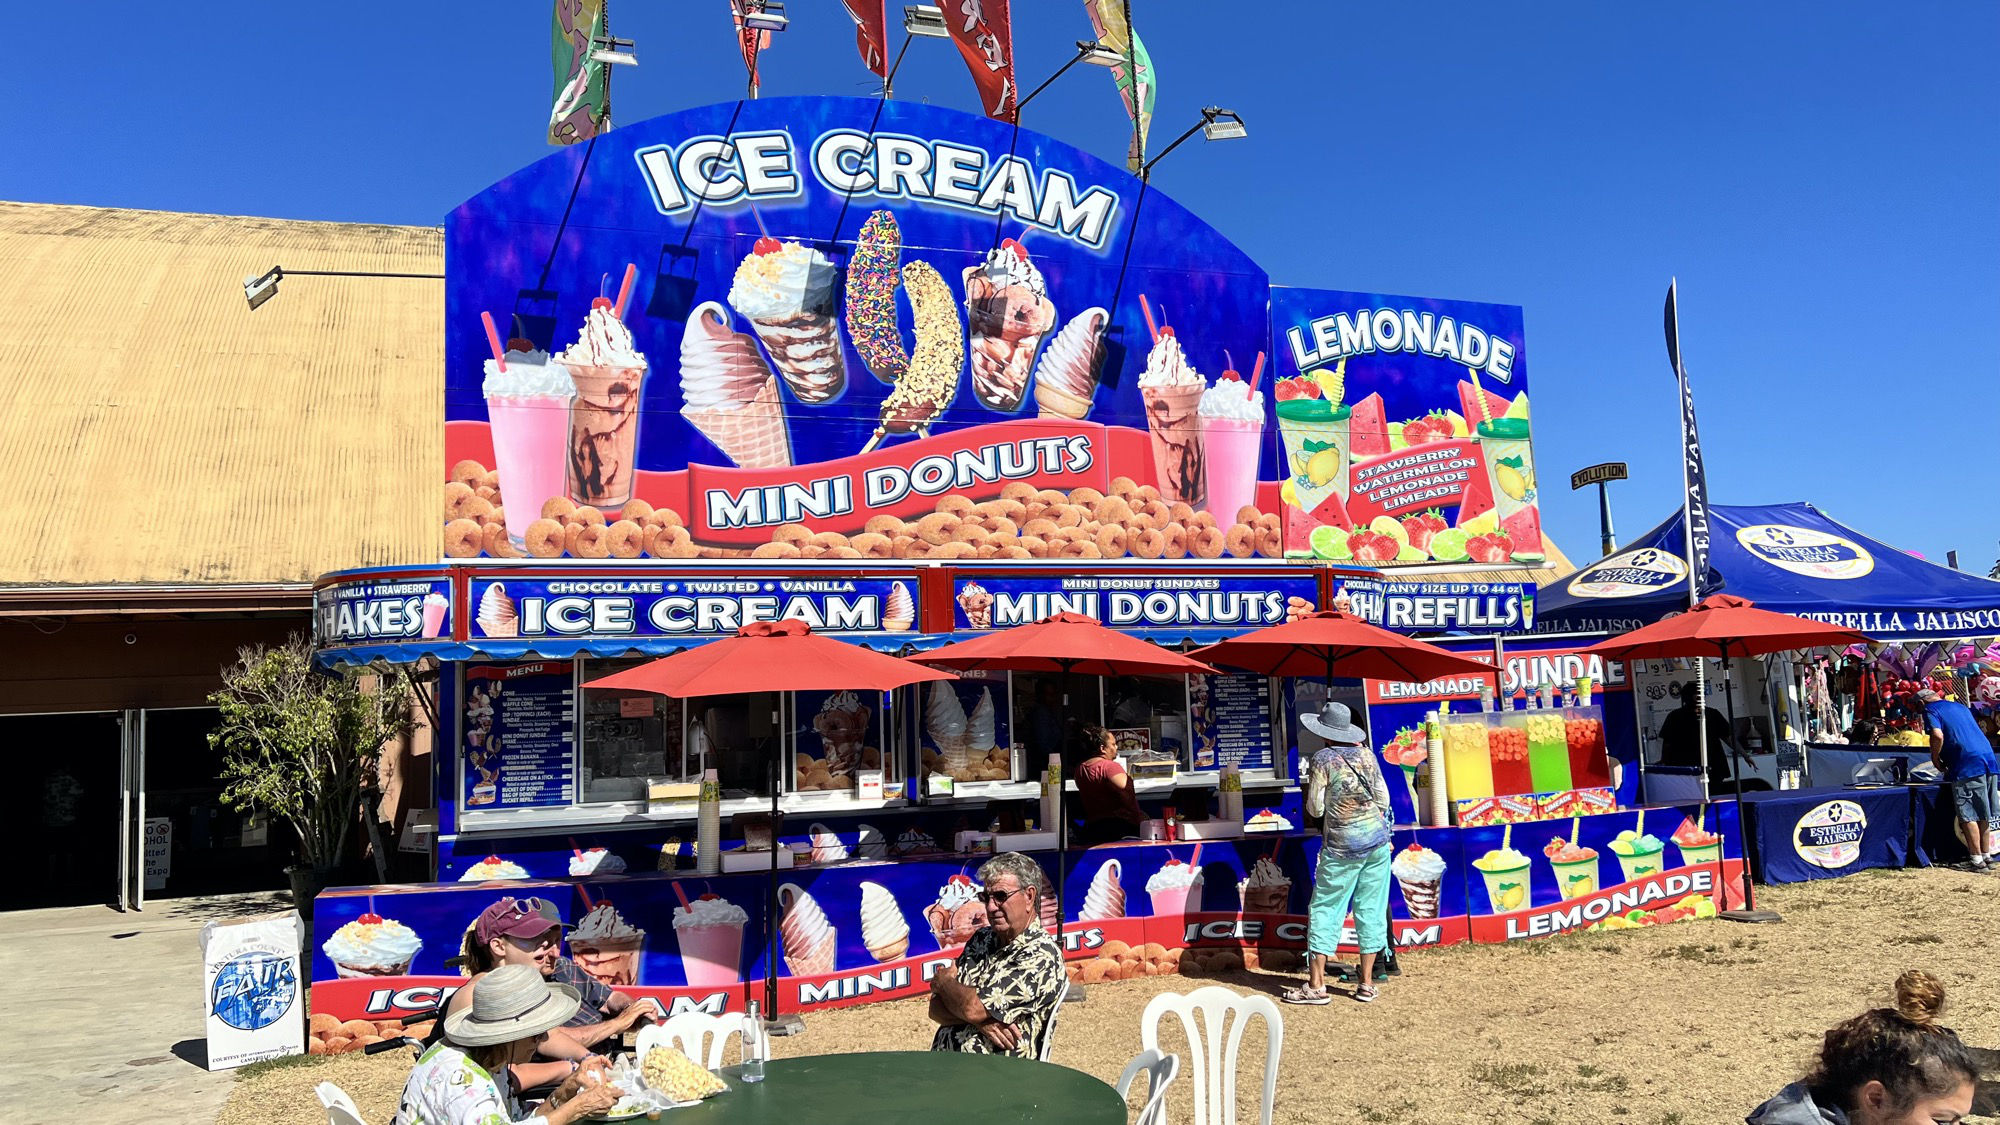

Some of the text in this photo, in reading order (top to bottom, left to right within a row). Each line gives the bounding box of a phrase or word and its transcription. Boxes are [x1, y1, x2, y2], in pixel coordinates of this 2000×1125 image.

[642, 131, 1118, 246] ICE CREAM
[1288, 308, 1514, 384] LEMONADE
[1357, 447, 1462, 481] STAWBERRY
[706, 436, 1093, 529] MINI DONUTS
[1352, 457, 1478, 495] WATERMELON
[1368, 470, 1469, 504] LEMONADE
[1572, 464, 1625, 488] EVOLUTION
[1382, 483, 1462, 511] LIMEADE
[1759, 544, 1840, 555] ESTRELLA
[1061, 578, 1220, 590] MINI DONUT SUNDAES
[1594, 574, 1652, 585] JALISCO
[1596, 567, 1666, 580] ESTRELLA
[338, 586, 366, 599] VANILLA
[373, 582, 432, 596] STRAWBERRY
[547, 581, 856, 594] CHOCOLATE TWISTED VANILLA
[1388, 585, 1419, 594] ANY
[1421, 584, 1448, 594] SIZE
[1450, 585, 1469, 594] UP
[1472, 585, 1489, 594] TO
[1491, 586, 1506, 594] 44
[521, 595, 880, 633] ICE CREAM
[995, 591, 1285, 625] MINI DONUTS
[1387, 597, 1520, 628] REFILLS
[1913, 608, 2000, 631] JALISCO
[1577, 618, 1643, 632] JALISCO
[506, 664, 544, 677] MENU
[1503, 653, 1626, 695] SUNDAE
[1379, 678, 1486, 700] LEMONADE
[1645, 684, 1668, 700] 805
[1463, 800, 1494, 823] LEMONADE
[1810, 823, 1861, 837] ESTRELLA
[1816, 833, 1857, 845] JALISCO
[147, 867, 168, 875] Expo
[1506, 871, 1713, 940] LEMONADE
[1183, 920, 1264, 943] ICE
[210, 947, 248, 974] VENTURA
[210, 955, 298, 1018] FAIR
[799, 966, 910, 1004] MINI
[212, 1053, 240, 1063] COURTESY
